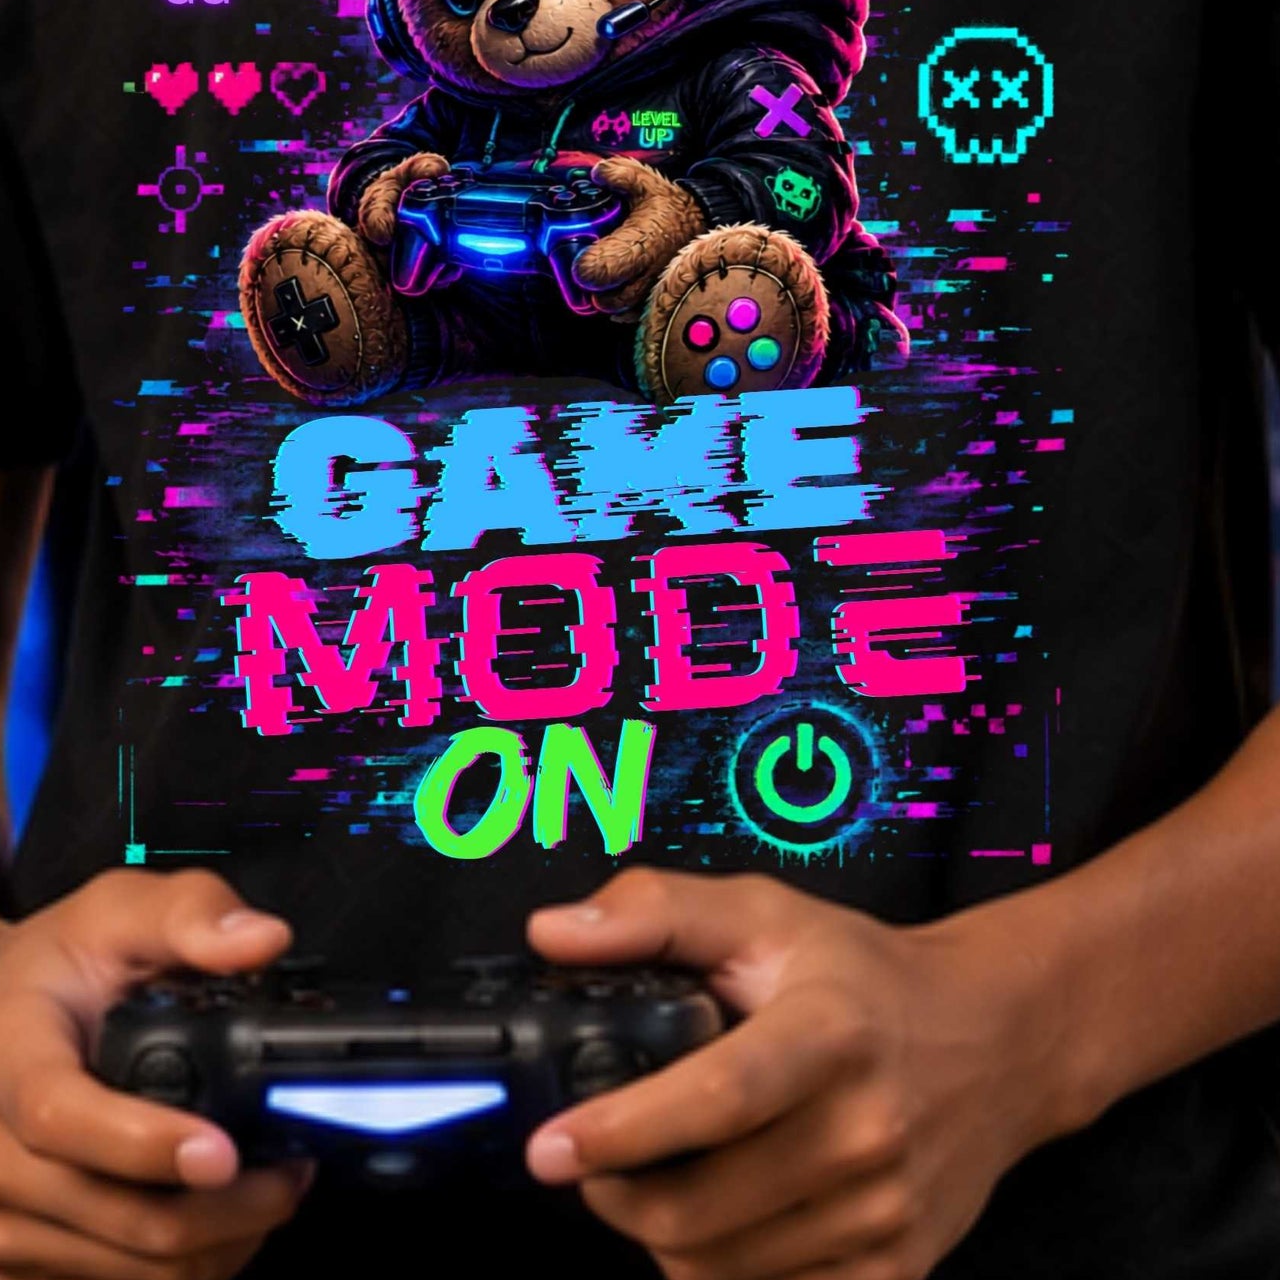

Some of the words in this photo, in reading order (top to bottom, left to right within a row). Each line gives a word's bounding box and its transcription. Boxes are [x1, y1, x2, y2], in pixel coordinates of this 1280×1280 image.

[632, 110, 682, 128] LEVEL
[639, 127, 674, 149] UP
[265, 385, 892, 559] GAME
[222, 529, 982, 737] MODE
[414, 718, 657, 860] ON
